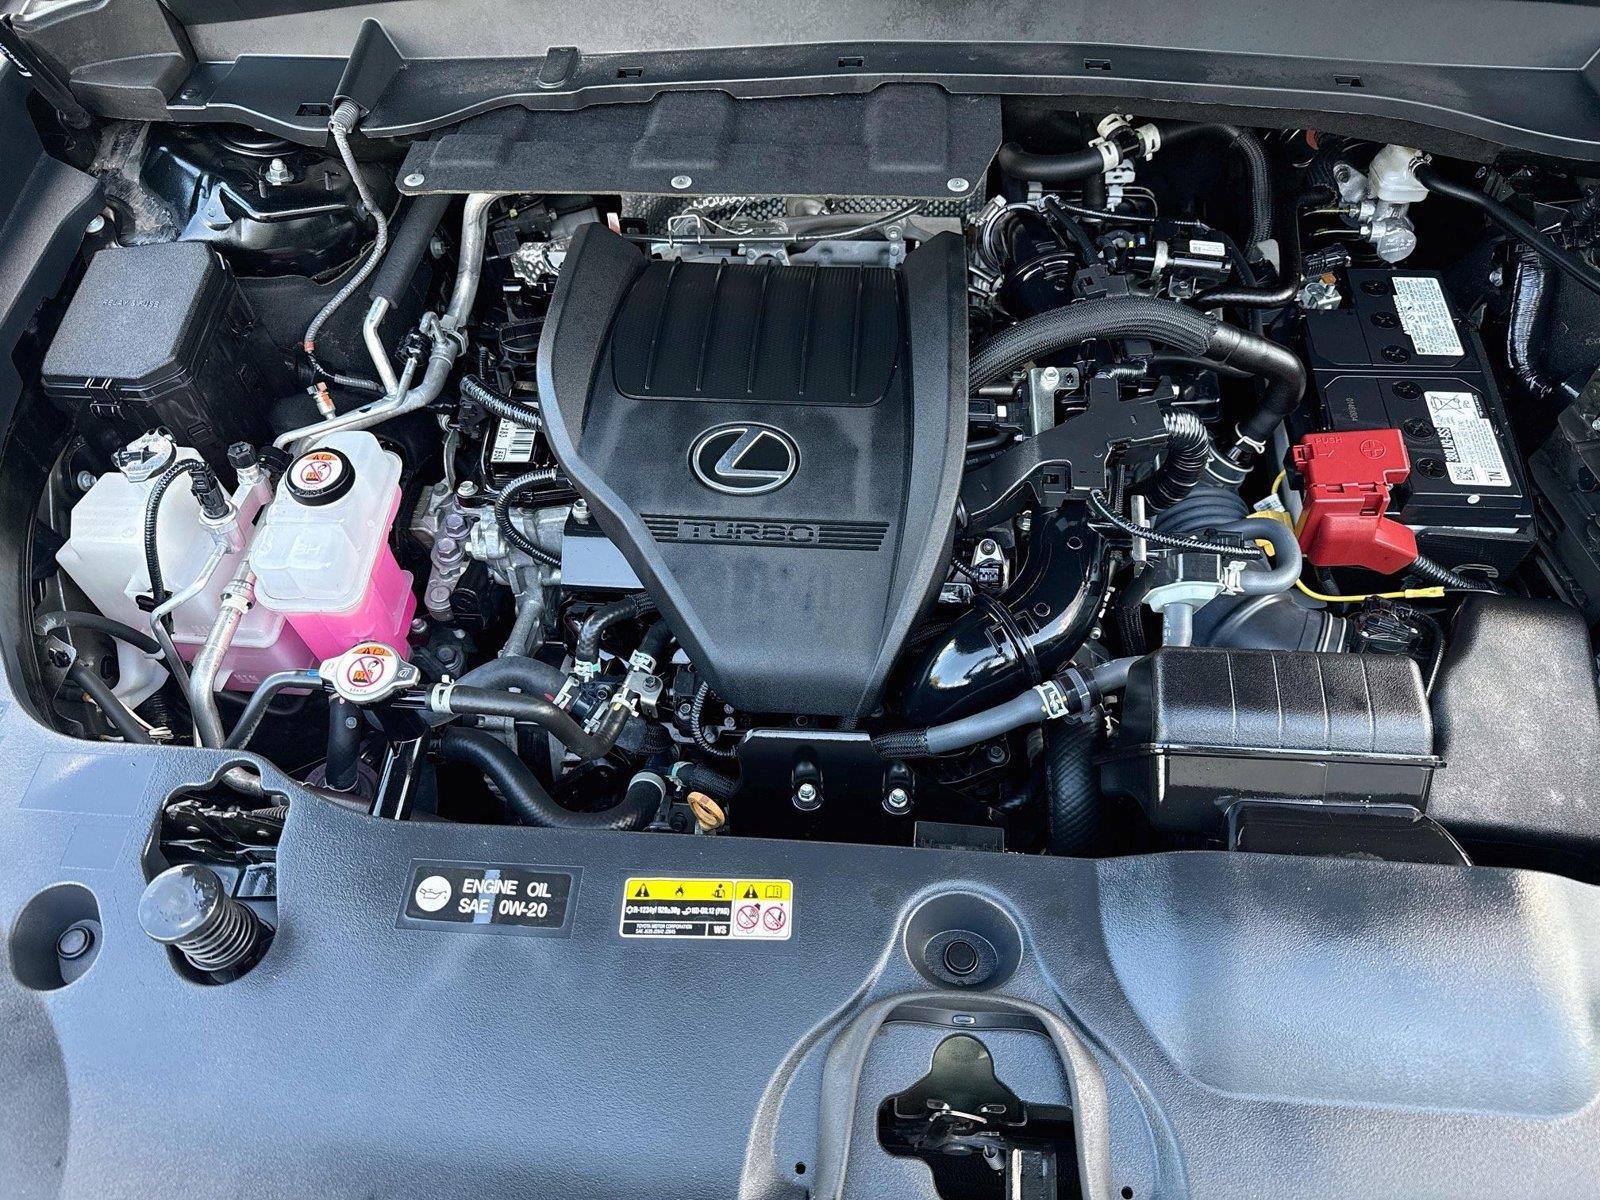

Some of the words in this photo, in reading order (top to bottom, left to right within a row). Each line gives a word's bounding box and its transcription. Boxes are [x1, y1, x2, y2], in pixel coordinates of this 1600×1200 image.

[1314, 436, 1343, 444] PUSH
[683, 521, 815, 543] TURBO
[462, 878, 519, 896] ENGINE
[526, 882, 552, 898] OIL
[458, 897, 491, 914] SAE
[499, 899, 548, 918] 0W-20
[713, 925, 727, 934] WS
